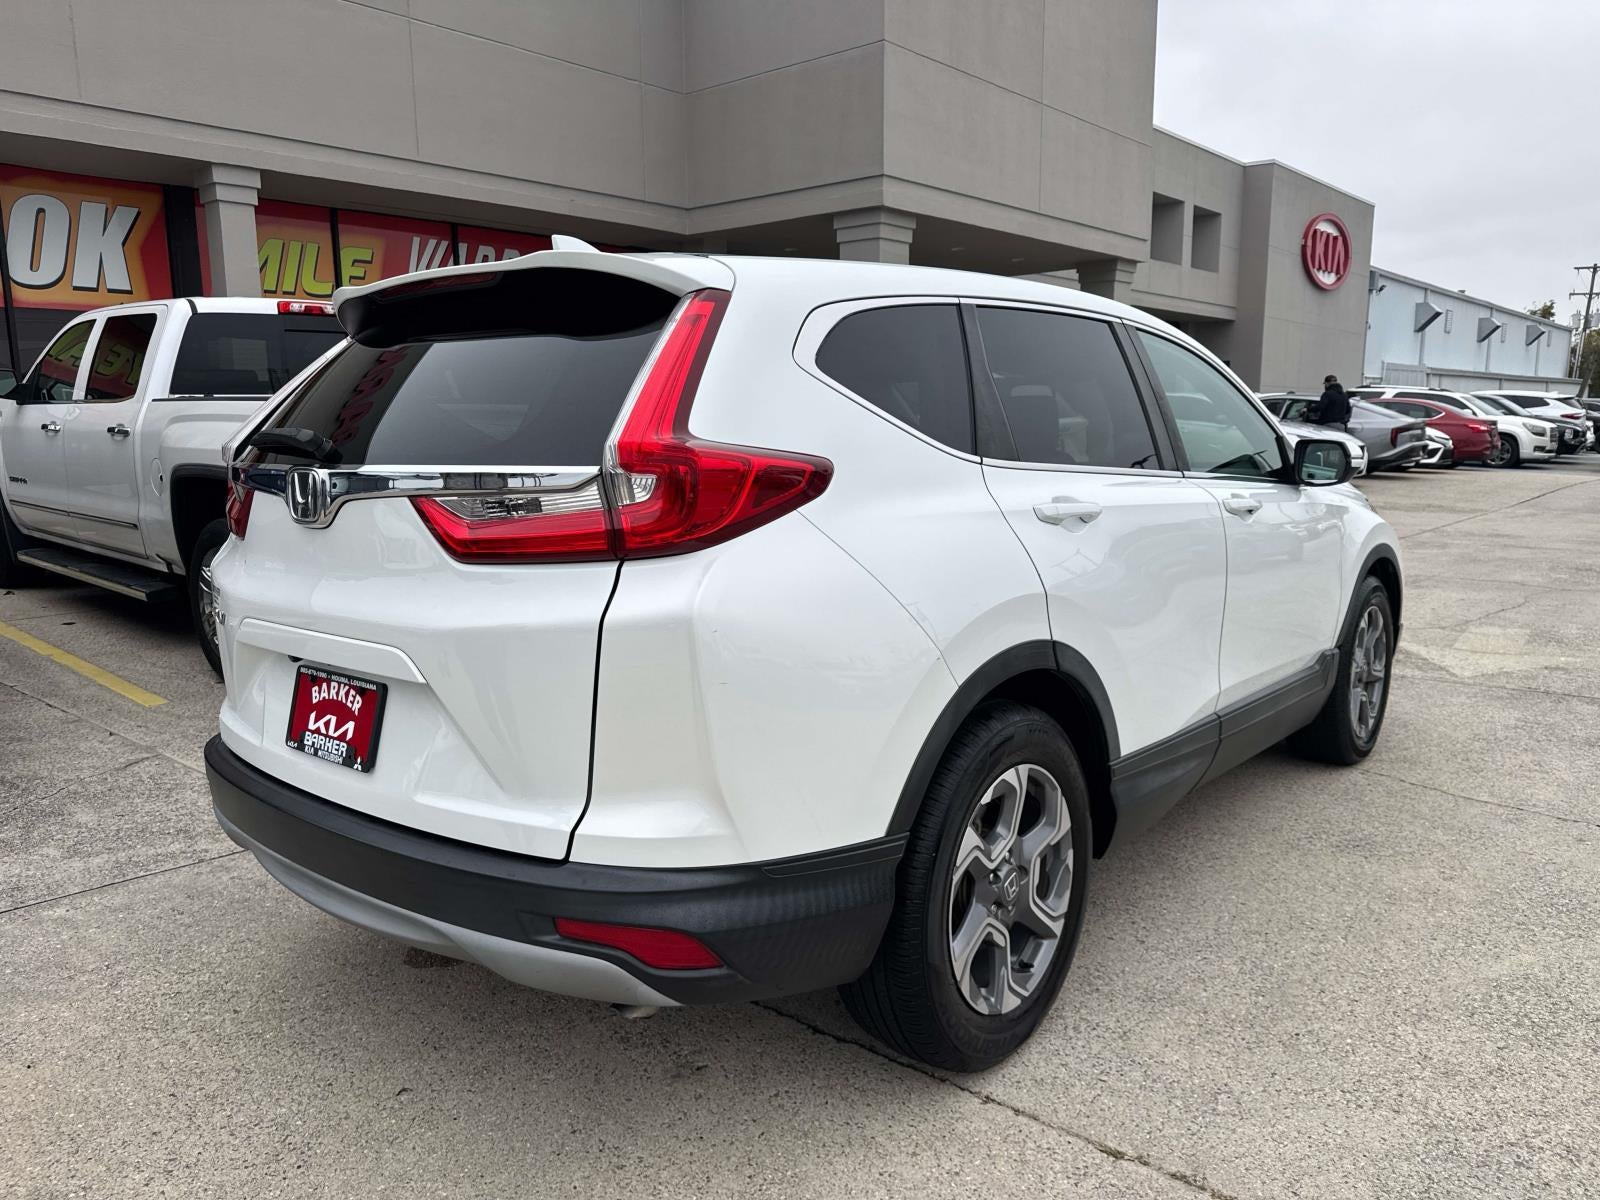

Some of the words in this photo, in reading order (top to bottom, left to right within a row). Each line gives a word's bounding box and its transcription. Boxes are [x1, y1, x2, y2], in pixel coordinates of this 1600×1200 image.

[1313, 227, 1345, 276] KIA
[311, 681, 363, 717] BARKER
[307, 710, 356, 741] KIA
[304, 745, 315, 755] KIA
